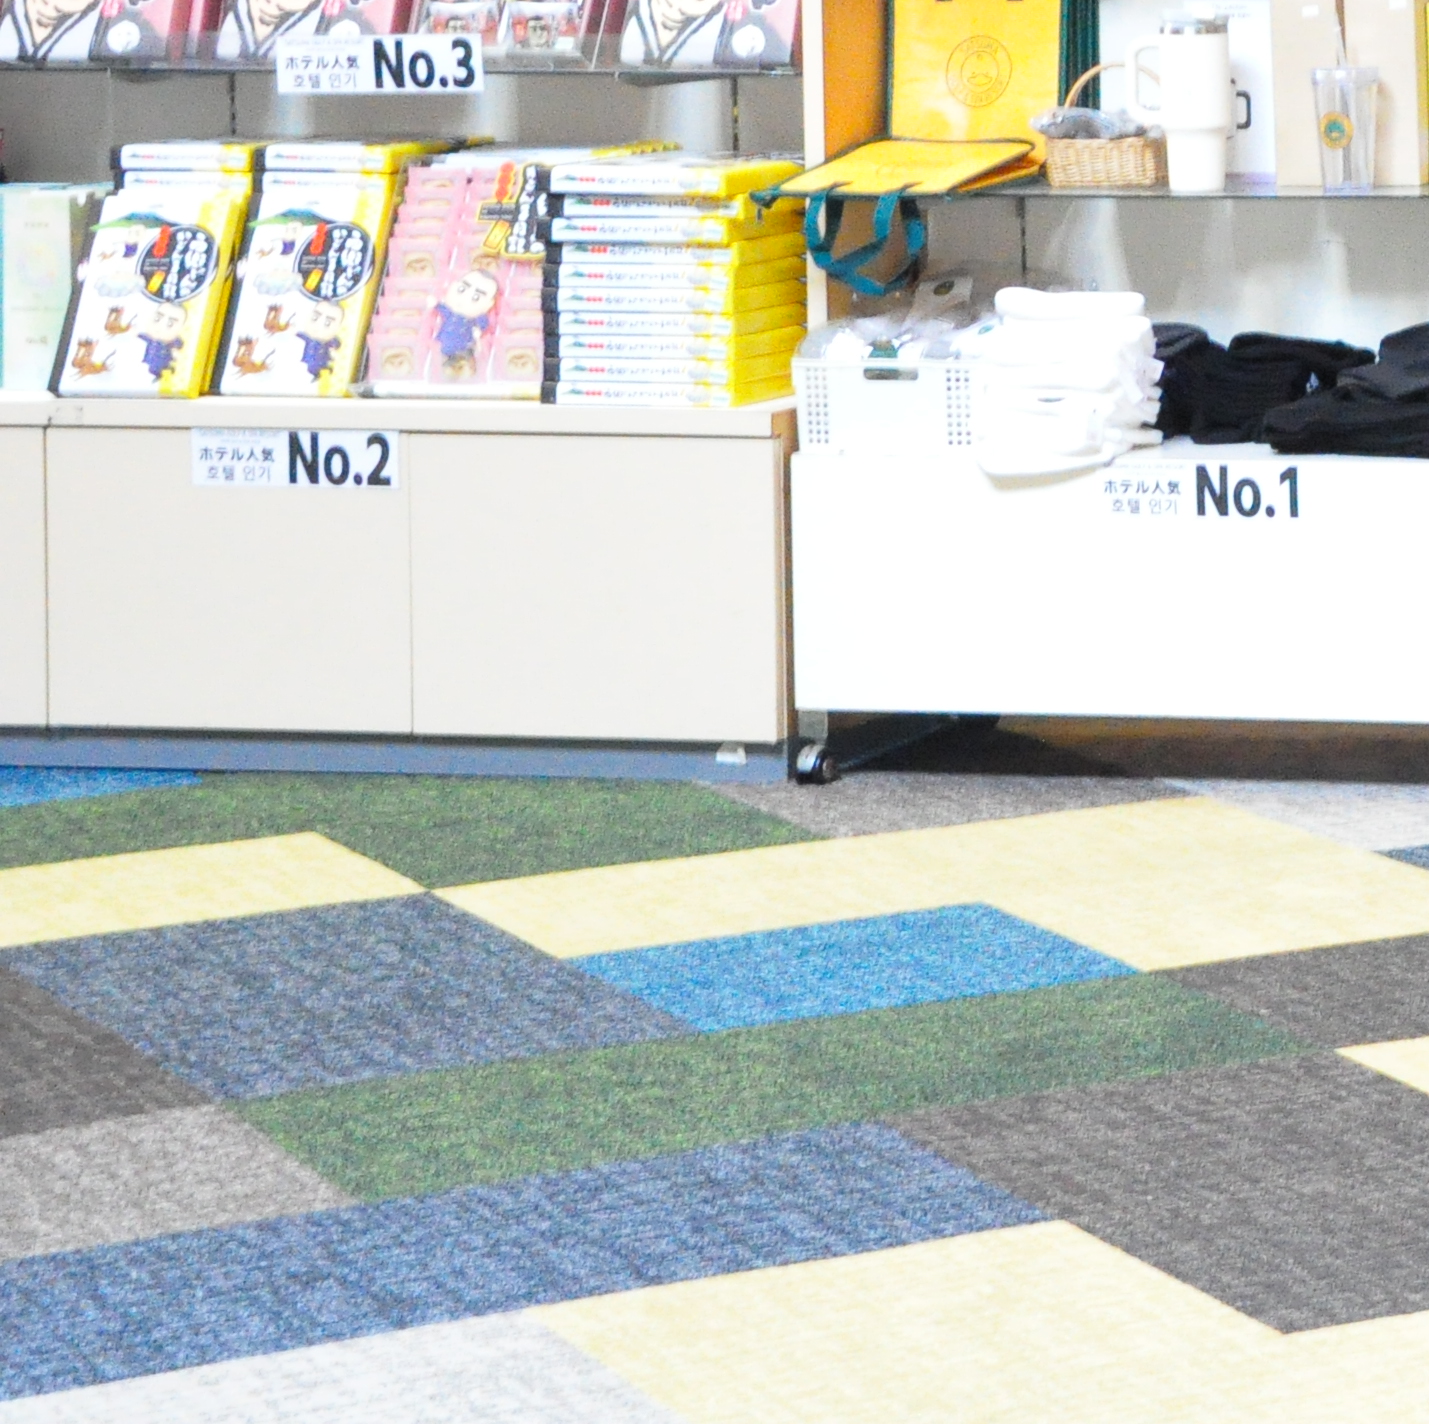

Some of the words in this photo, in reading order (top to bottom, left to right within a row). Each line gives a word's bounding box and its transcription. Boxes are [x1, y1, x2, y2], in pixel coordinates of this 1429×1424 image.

[285, 54, 360, 70] ホテル人気
[373, 37, 475, 89] No.3
[199, 447, 275, 463] ホテル人気
[288, 431, 391, 486] No.2
[1104, 479, 1182, 495] ホテル人気
[1196, 464, 1299, 518] No.1
